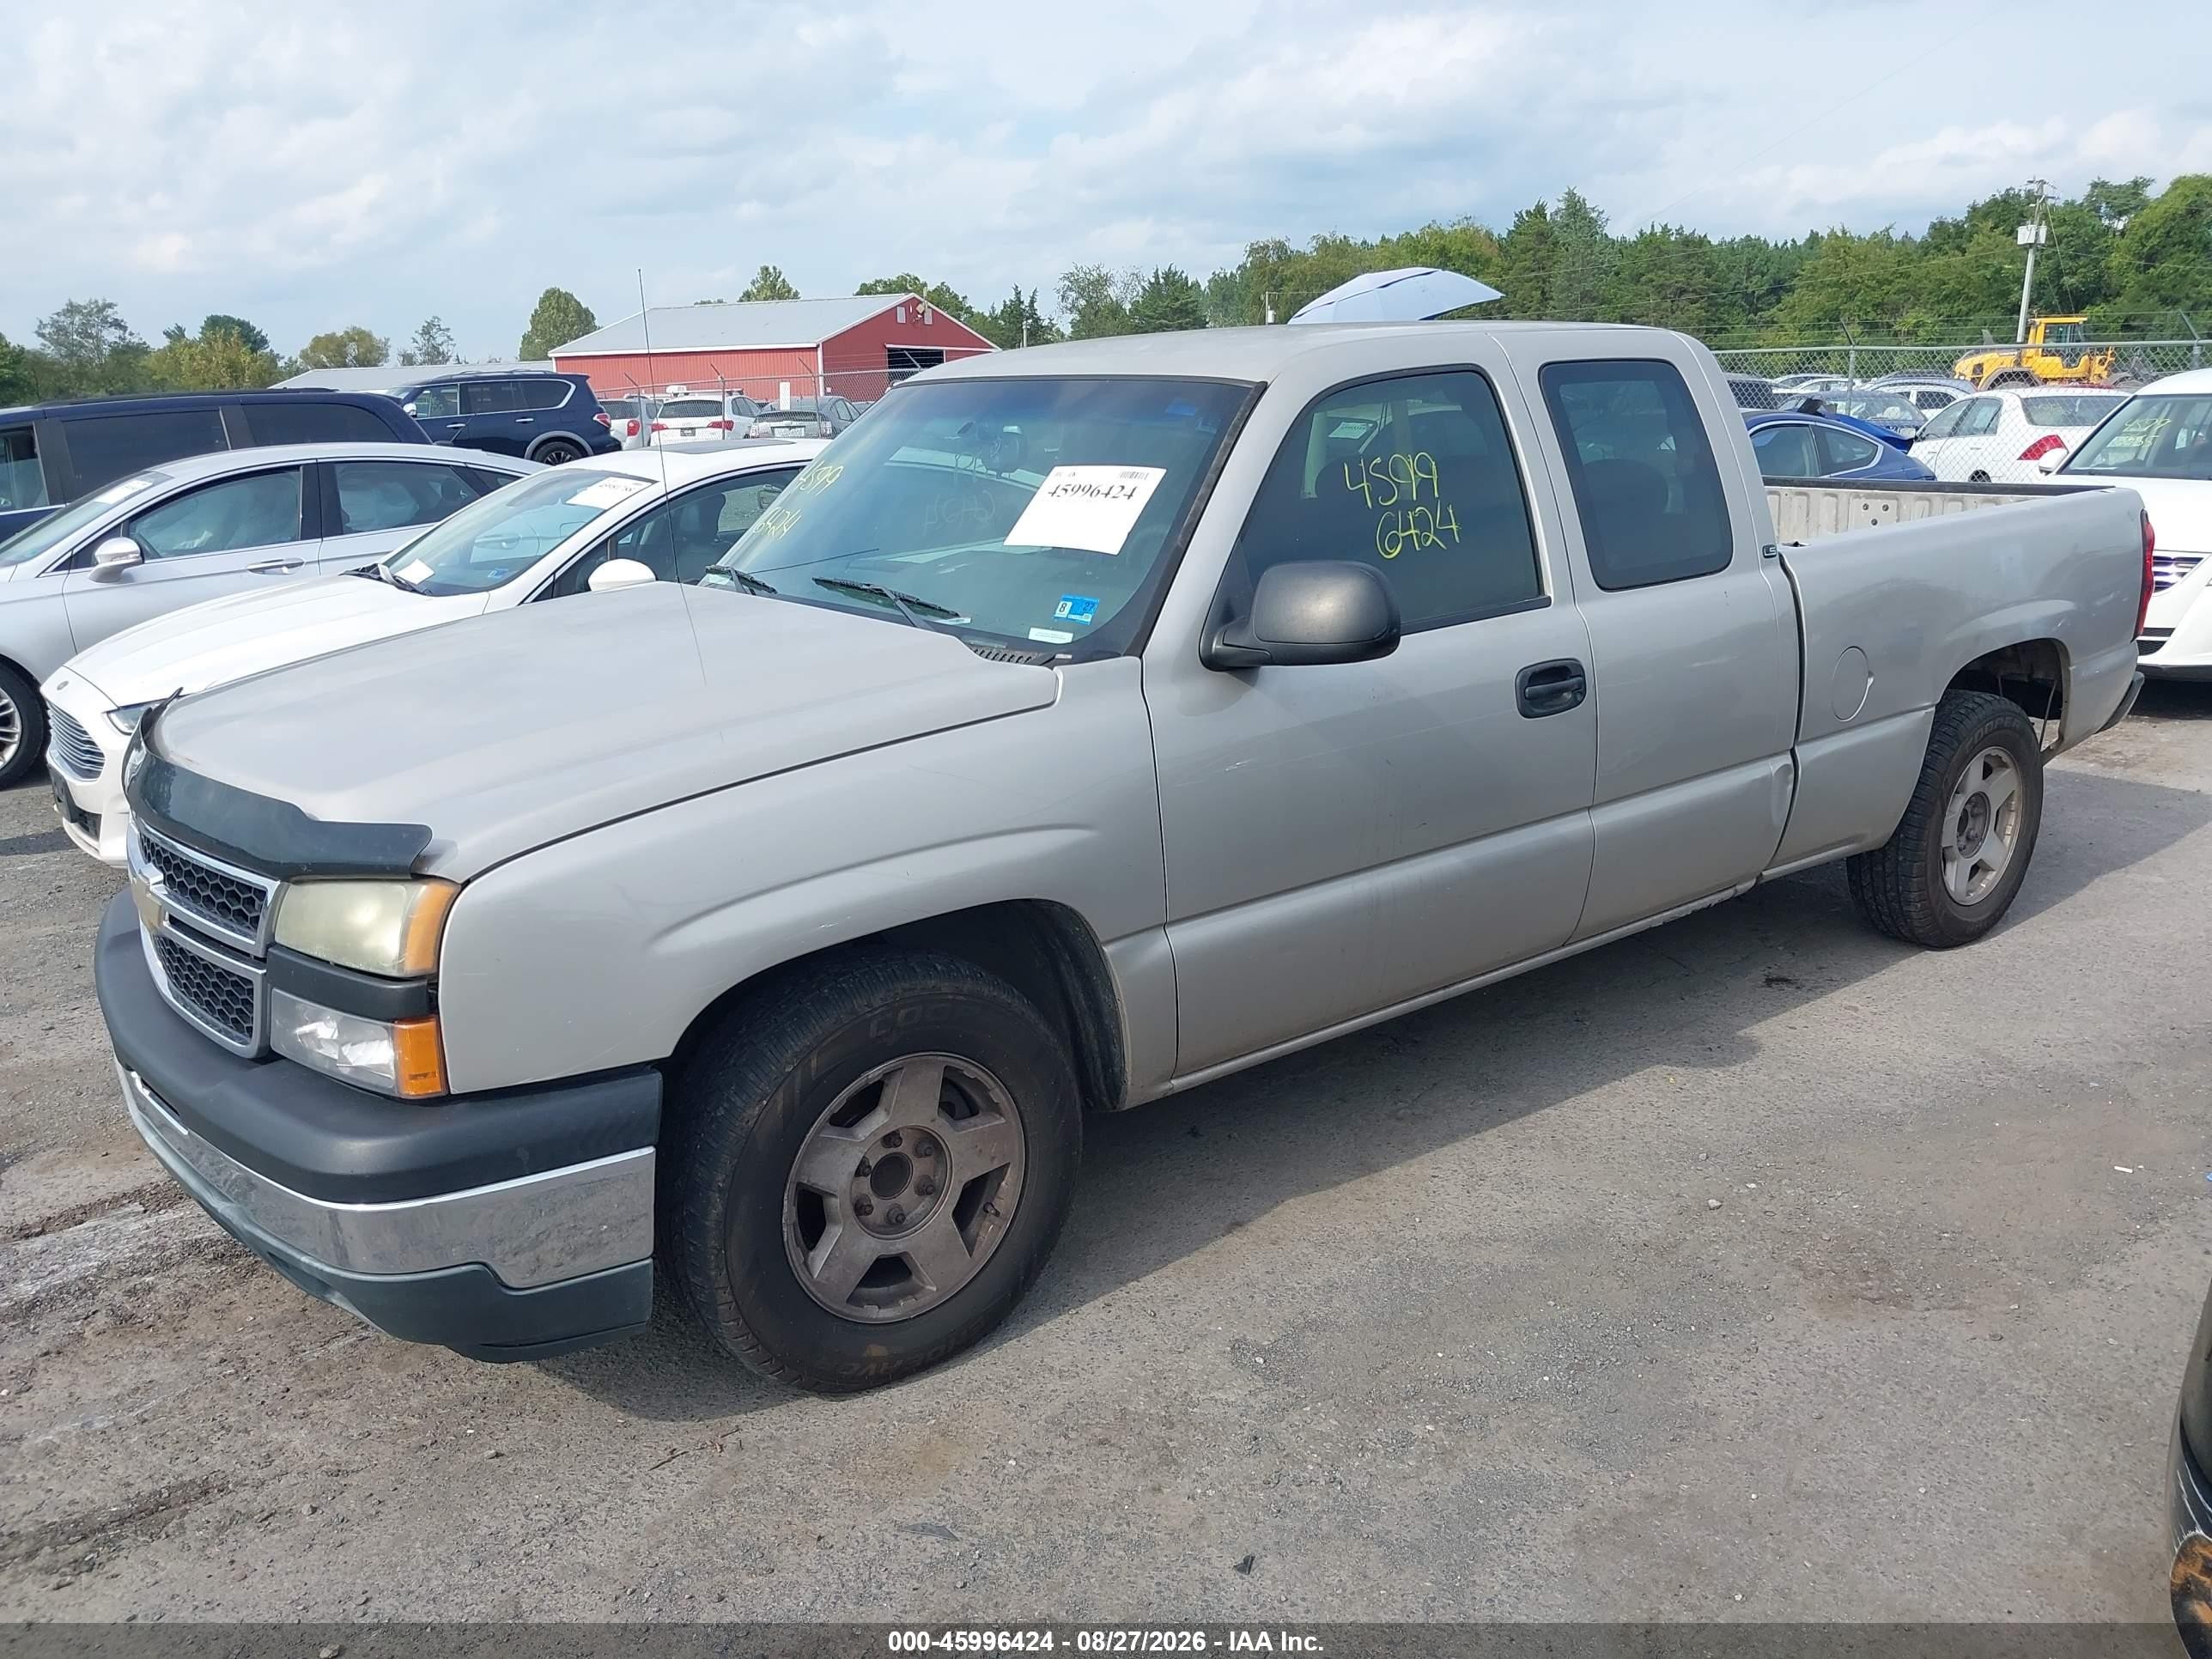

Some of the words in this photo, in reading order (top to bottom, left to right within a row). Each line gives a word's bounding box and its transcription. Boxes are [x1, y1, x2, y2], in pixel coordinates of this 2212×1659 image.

[1343, 452, 1439, 509] 4599
[1048, 483, 1139, 500] 45996424
[1375, 500, 1462, 560] 6424
[1764, 546, 1777, 556] LS
[1059, 602, 1067, 613] 8
[1083, 602, 1096, 612] 27
